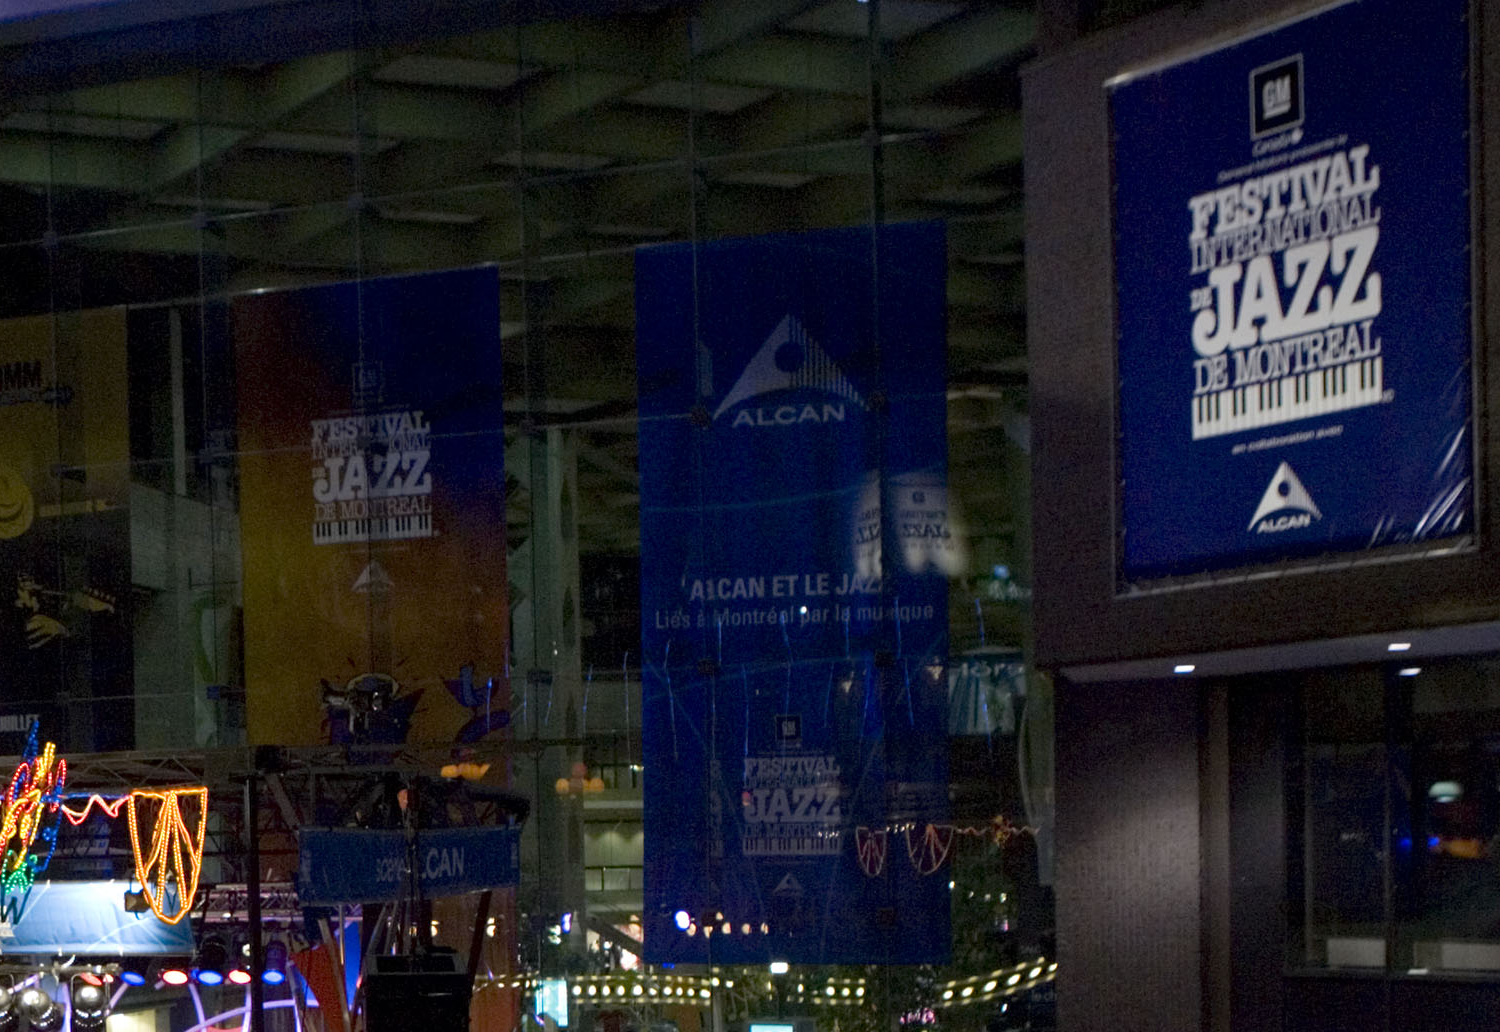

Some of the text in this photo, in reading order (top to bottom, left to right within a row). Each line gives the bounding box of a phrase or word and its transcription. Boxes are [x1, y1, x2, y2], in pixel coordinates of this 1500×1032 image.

[1189, 143, 1380, 239] FESTIVAL
[1190, 192, 1380, 274] INTERNATIONAL
[1190, 285, 1211, 311] DE
[1192, 226, 1381, 356] JAZZ
[1194, 357, 1228, 395] DE
[310, 410, 431, 441] FESTIVAL
[731, 404, 846, 429] ALCAN
[312, 451, 432, 503] JAZZ
[315, 503, 336, 521] DE
[1257, 514, 1311, 534] ALCAN
[772, 574, 799, 598] ET
[804, 573, 831, 596] LE
[744, 756, 840, 775] FESTIVAL
[744, 788, 841, 823] JAZZ
